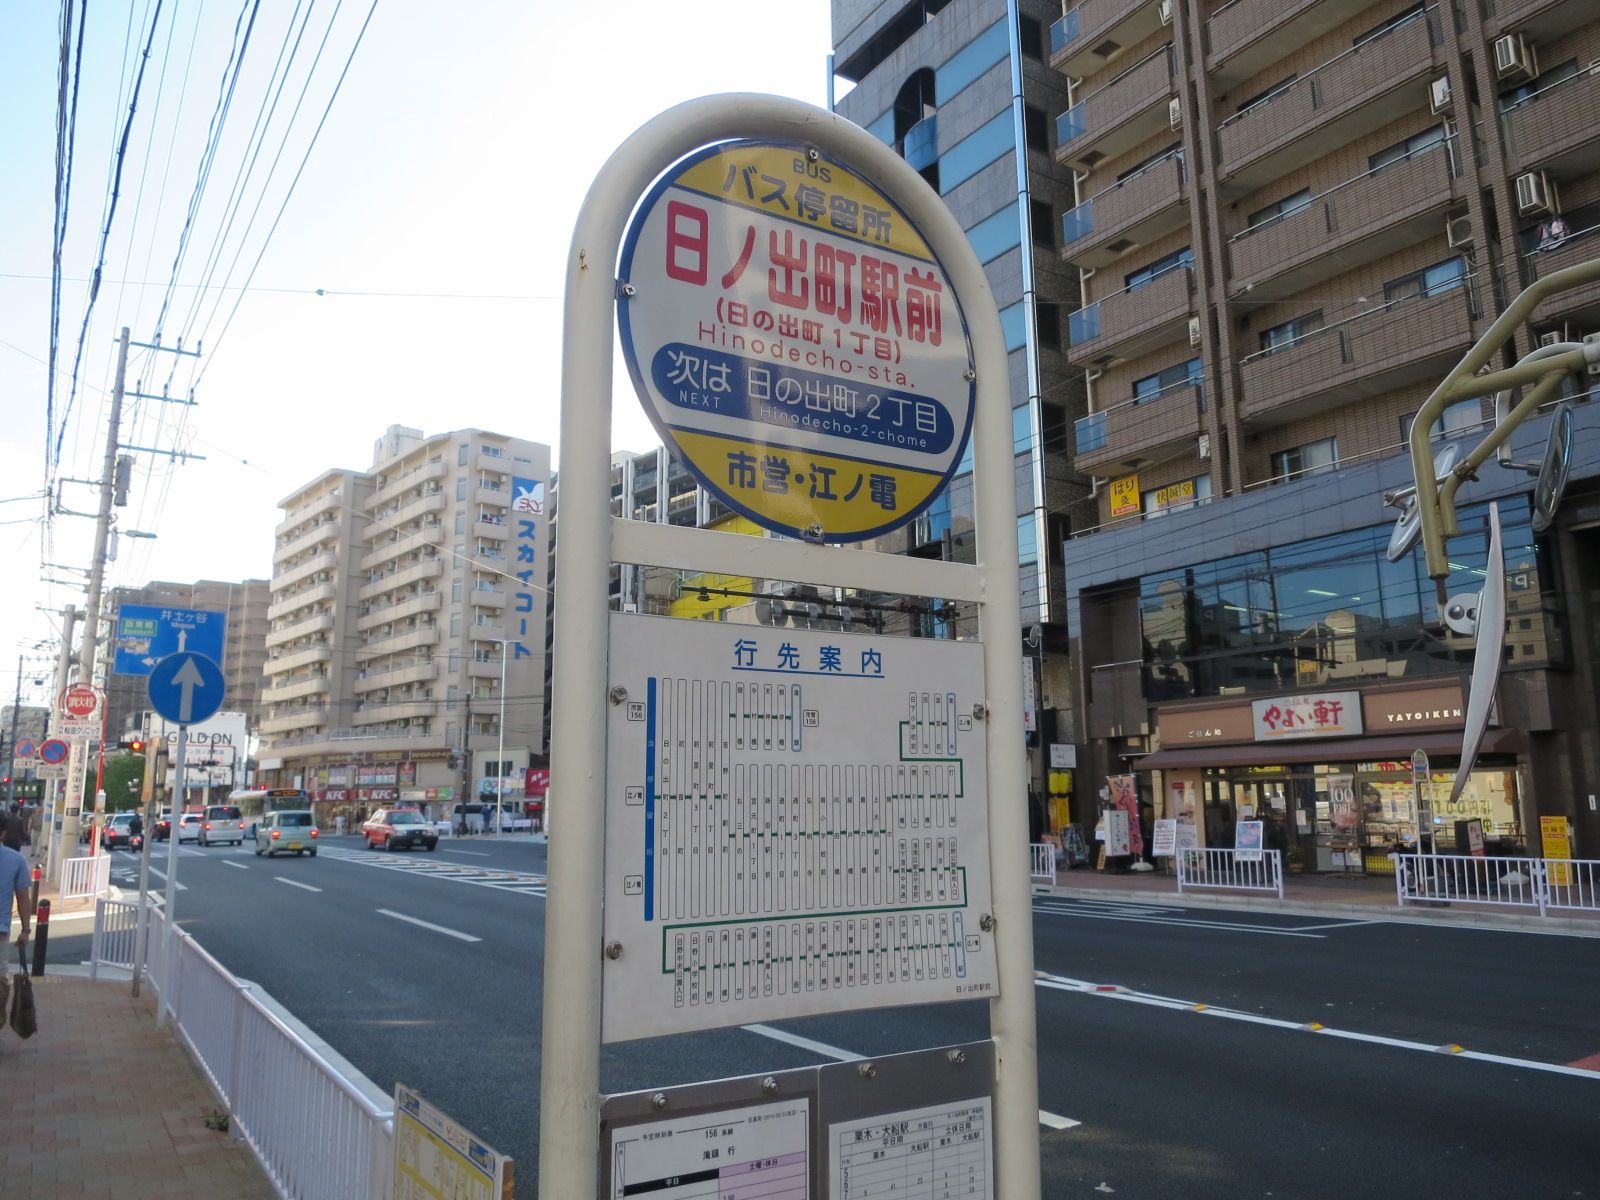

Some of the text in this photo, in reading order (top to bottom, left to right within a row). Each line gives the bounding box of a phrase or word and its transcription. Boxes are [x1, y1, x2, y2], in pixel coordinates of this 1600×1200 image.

[793, 159, 832, 182] BUS
[723, 164, 892, 244] バス停留所
[665, 199, 942, 347] 日ノ出町駅前
[699, 321, 916, 389] Hinodecho-sta.
[667, 350, 938, 434] 次は 日の出町2丁目
[679, 390, 720, 409] NEXT
[759, 405, 928, 449] Hinodecho-2-chome
[726, 451, 897, 511] 市営・江ノ電
[1113, 479, 1134, 496] はり
[515, 519, 536, 660] スカイコート
[734, 638, 882, 674] 行先案内
[630, 711, 643, 719] 156
[1262, 699, 1344, 730] やよい軒
[1387, 708, 1462, 723] YAYOIKEN
[168, 731, 208, 744] GLD
[325, 790, 346, 801] KFC
[371, 789, 391, 800] KFC
[705, 1128, 718, 1139] 156
[728, 1146, 736, 1156] 行
[665, 1177, 680, 1186] 平日
